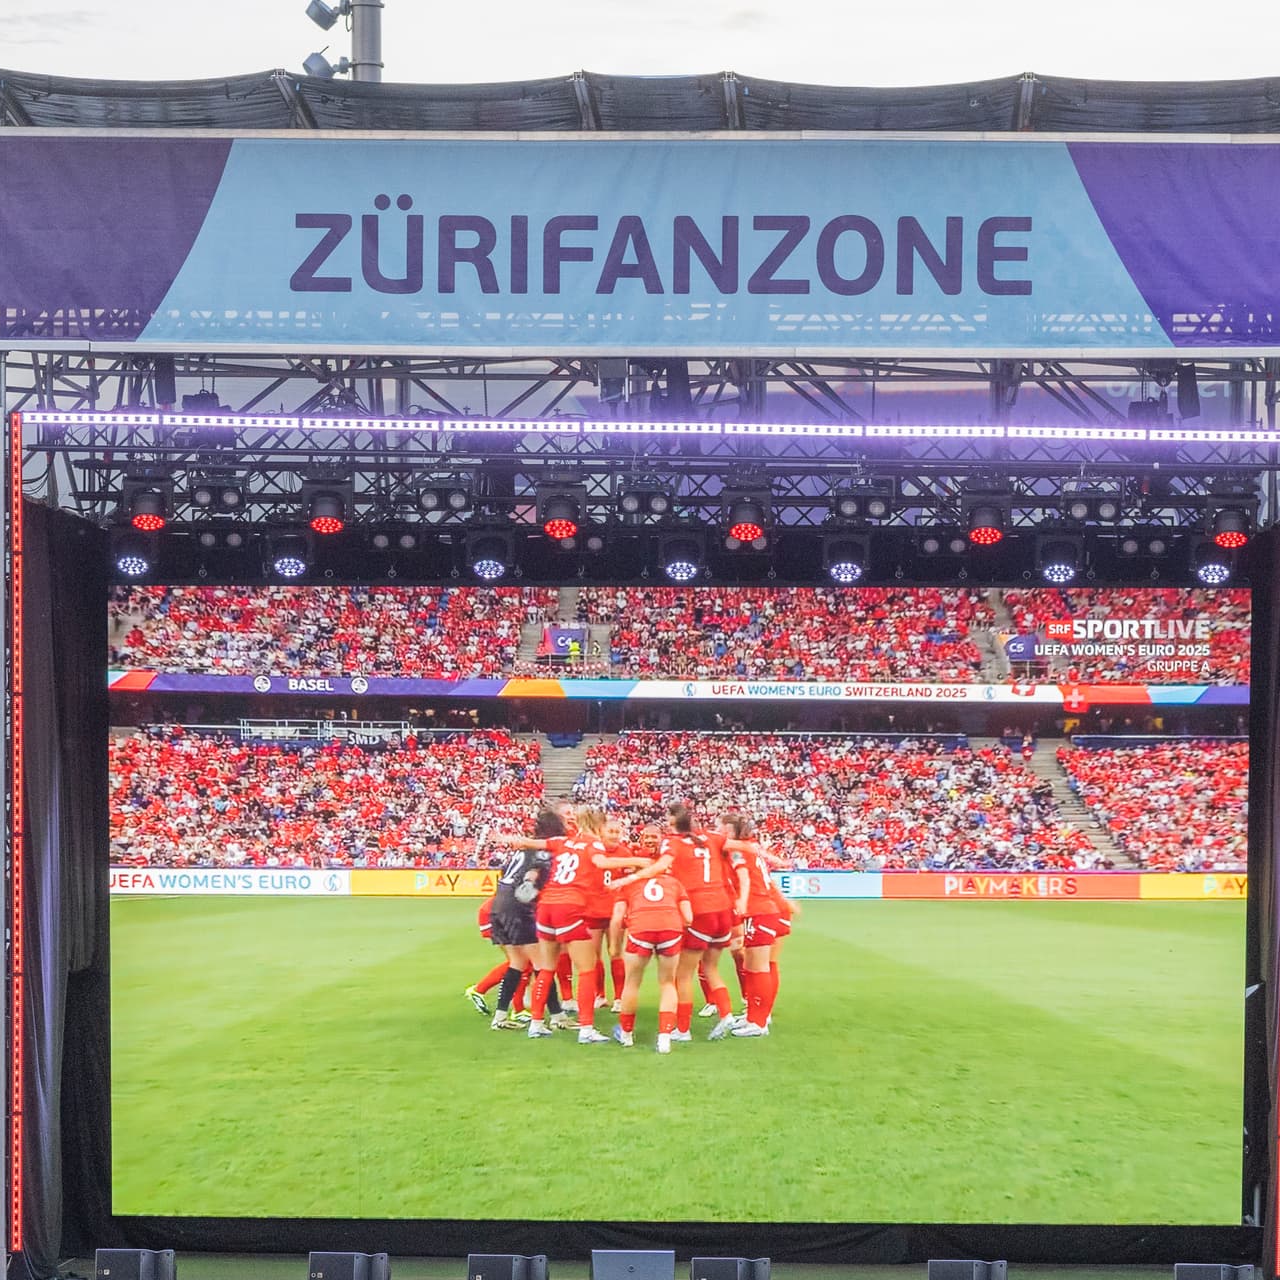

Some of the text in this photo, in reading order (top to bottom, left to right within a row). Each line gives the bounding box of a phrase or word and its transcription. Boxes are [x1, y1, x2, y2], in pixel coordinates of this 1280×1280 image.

[290, 193, 1033, 296] ZÜRIFANZONE
[1048, 624, 1071, 635] SRF
[1034, 643, 1211, 656] UEFA WOMEN'S EURO 2025
[1147, 660, 1211, 672] GRUPPE A
[288, 679, 334, 691] BASEL
[712, 685, 968, 698] UEFA WOMEN'S EURO SWITZERLAND 2025
[347, 733, 381, 745] SMD
[694, 849, 711, 883] 7
[159, 874, 253, 890] WOMEN'S
[259, 874, 312, 890] EURO
[944, 875, 1078, 896] PLAYMAKERS
[643, 879, 664, 901] 6
